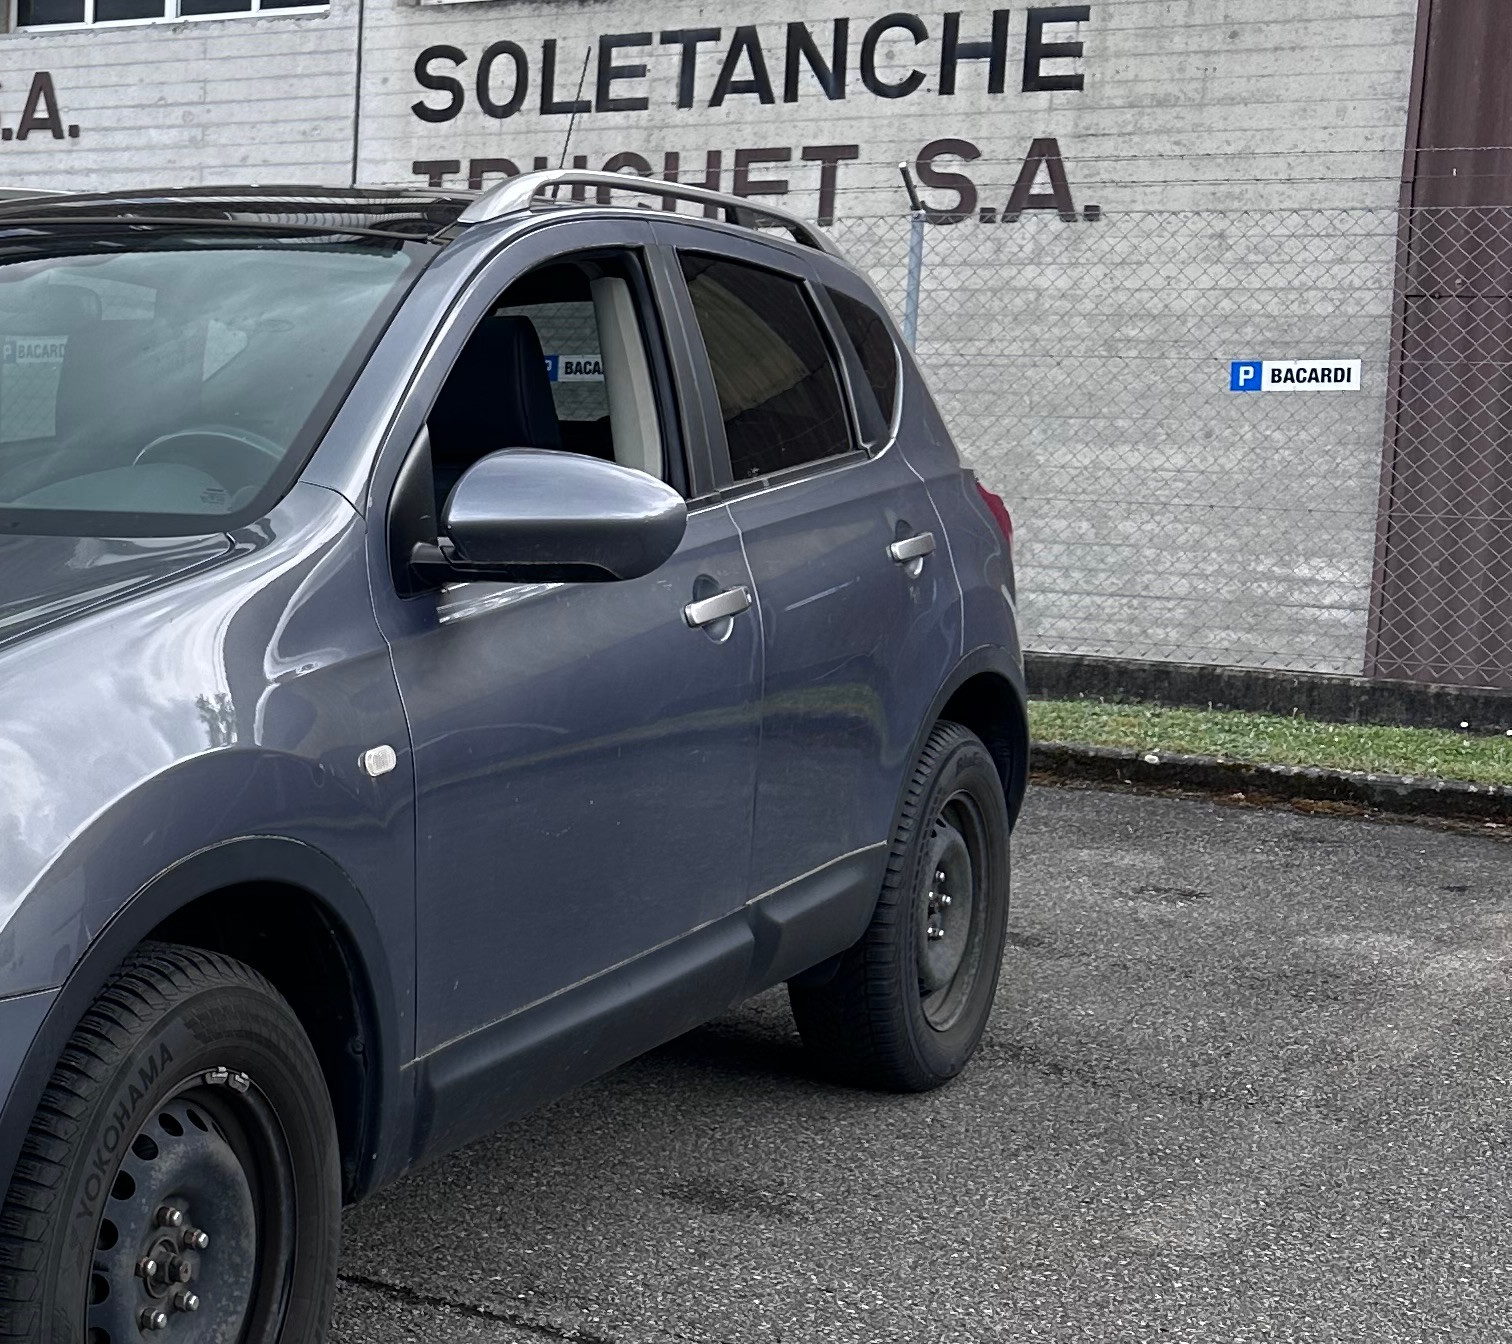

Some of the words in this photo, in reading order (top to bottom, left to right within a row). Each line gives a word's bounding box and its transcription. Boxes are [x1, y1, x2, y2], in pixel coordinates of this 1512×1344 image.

[411, 6, 1090, 122] SOLETANCHE
[412, 144, 859, 226] TCHET
[917, 138, 1100, 226] S.A.
[1239, 366, 1254, 386] P
[1271, 367, 1351, 383] BACARDI
[75, 1042, 173, 1219] YOKOHAMA
